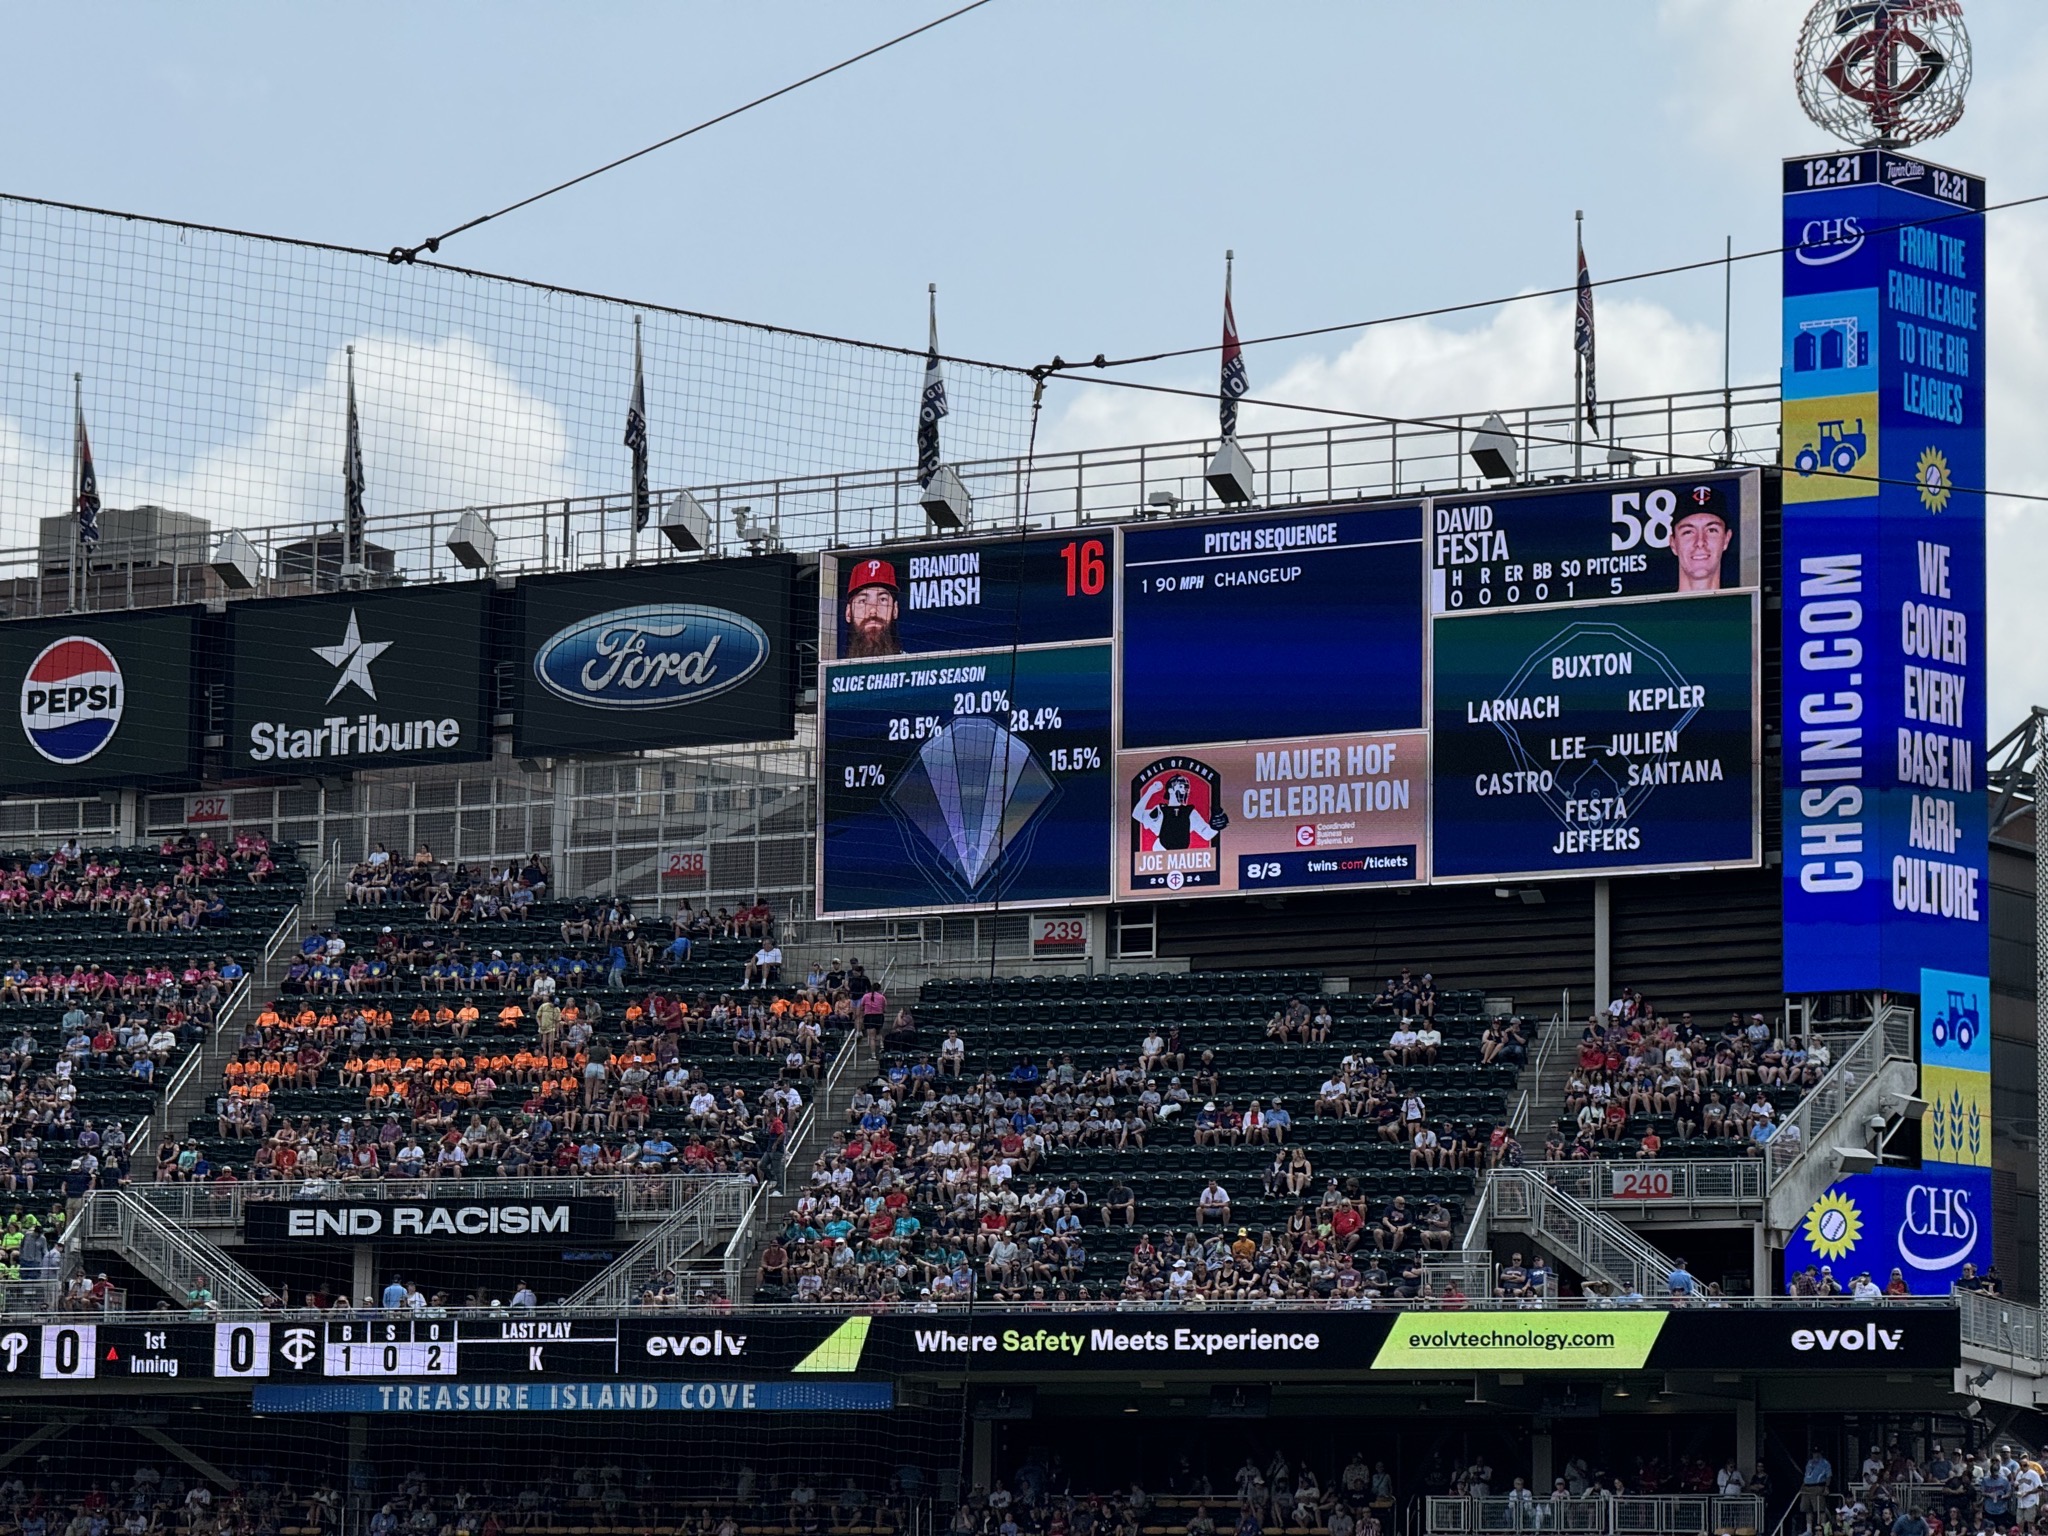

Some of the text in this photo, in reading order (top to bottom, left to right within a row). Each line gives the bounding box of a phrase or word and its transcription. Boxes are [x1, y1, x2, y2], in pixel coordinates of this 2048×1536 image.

[1804, 155, 1860, 187] 12:21
[1932, 170, 1968, 203] 12:21
[1803, 216, 1859, 248] CHS
[1899, 223, 1966, 279] FROM THE
[1888, 269, 1978, 331] FARM LEAGUE
[1897, 321, 1969, 378] TO THE BIG
[1903, 371, 1963, 425] LEAGUES
[1436, 505, 1493, 534] DAVID
[1611, 489, 1677, 551] 58
[1204, 523, 1338, 554] PITCH SEQUENCE
[1437, 530, 1510, 566] FESTA
[909, 552, 980, 579] BRANDON
[1060, 540, 1106, 597] 16
[1141, 566, 1302, 593] 1 90 MPH CHANGEUP
[1452, 554, 1647, 587] H R ER BB SO PITCHES
[1917, 540, 1951, 599] WE
[909, 577, 981, 610] MARSH
[1451, 577, 1623, 608] 0 0 0 0 1 5
[1902, 601, 1967, 666] COVER
[581, 624, 722, 692] Ford
[1552, 651, 1632, 679] BUXTON
[832, 676, 864, 693] SLICE
[938, 666, 986, 685] SEASON
[27, 684, 118, 716] PEPSI
[953, 690, 1010, 715] 20.0%
[1467, 695, 1560, 723] LARNACH
[1628, 685, 1705, 712] KEPLER
[1904, 665, 1966, 729] EVERY
[889, 716, 942, 741] 26.5%
[1009, 707, 1062, 732] 28.4%
[1800, 553, 1864, 894] CHSINC.COM
[250, 714, 460, 761] StarTribune
[1550, 736, 1586, 760] LEE
[1606, 730, 1678, 757] JULIEN
[1049, 747, 1100, 771] 15.5%
[1140, 759, 1214, 782] HALL OF FAME
[1255, 743, 1396, 782] MAUER HOF
[1627, 759, 1723, 786] SANTANA
[1898, 727, 1972, 793] BASE IN
[844, 765, 885, 788] 9.7%
[1475, 770, 1553, 796] CASTRO
[195, 799, 226, 817] 237
[1242, 779, 1410, 820] CELEBRATION
[1565, 798, 1627, 822] FESTA
[1909, 795, 1962, 854] AGRI-
[1553, 827, 1640, 854] JEFFERS
[670, 854, 703, 873] 238
[1139, 852, 1211, 872] JOE MAUER
[1247, 855, 1408, 879] 8/3 twins.com/tickets
[1892, 855, 1979, 922] CULTURE
[1044, 921, 1083, 941] 239
[1623, 1173, 1668, 1195] 240
[288, 1206, 570, 1237] END RACISM
[1905, 1184, 1970, 1239] CHS
[144, 1331, 166, 1350] 1st
[342, 1325, 352, 1342] B
[386, 1325, 396, 1341] S
[502, 1322, 572, 1339] LAST PLAY
[646, 1330, 747, 1357] evolv
[915, 1328, 1320, 1356] Where Safety Meets Experience
[1409, 1328, 1615, 1352] evolvtechnology.com
[1791, 1323, 1904, 1352] evolv
[56, 1329, 80, 1374] 0
[230, 1327, 254, 1372] 0
[342, 1345, 441, 1372] 1 0 2
[529, 1346, 543, 1371] K
[131, 1355, 178, 1377] Inning
[379, 1383, 757, 1410] TREASURE ISLAND COVE
